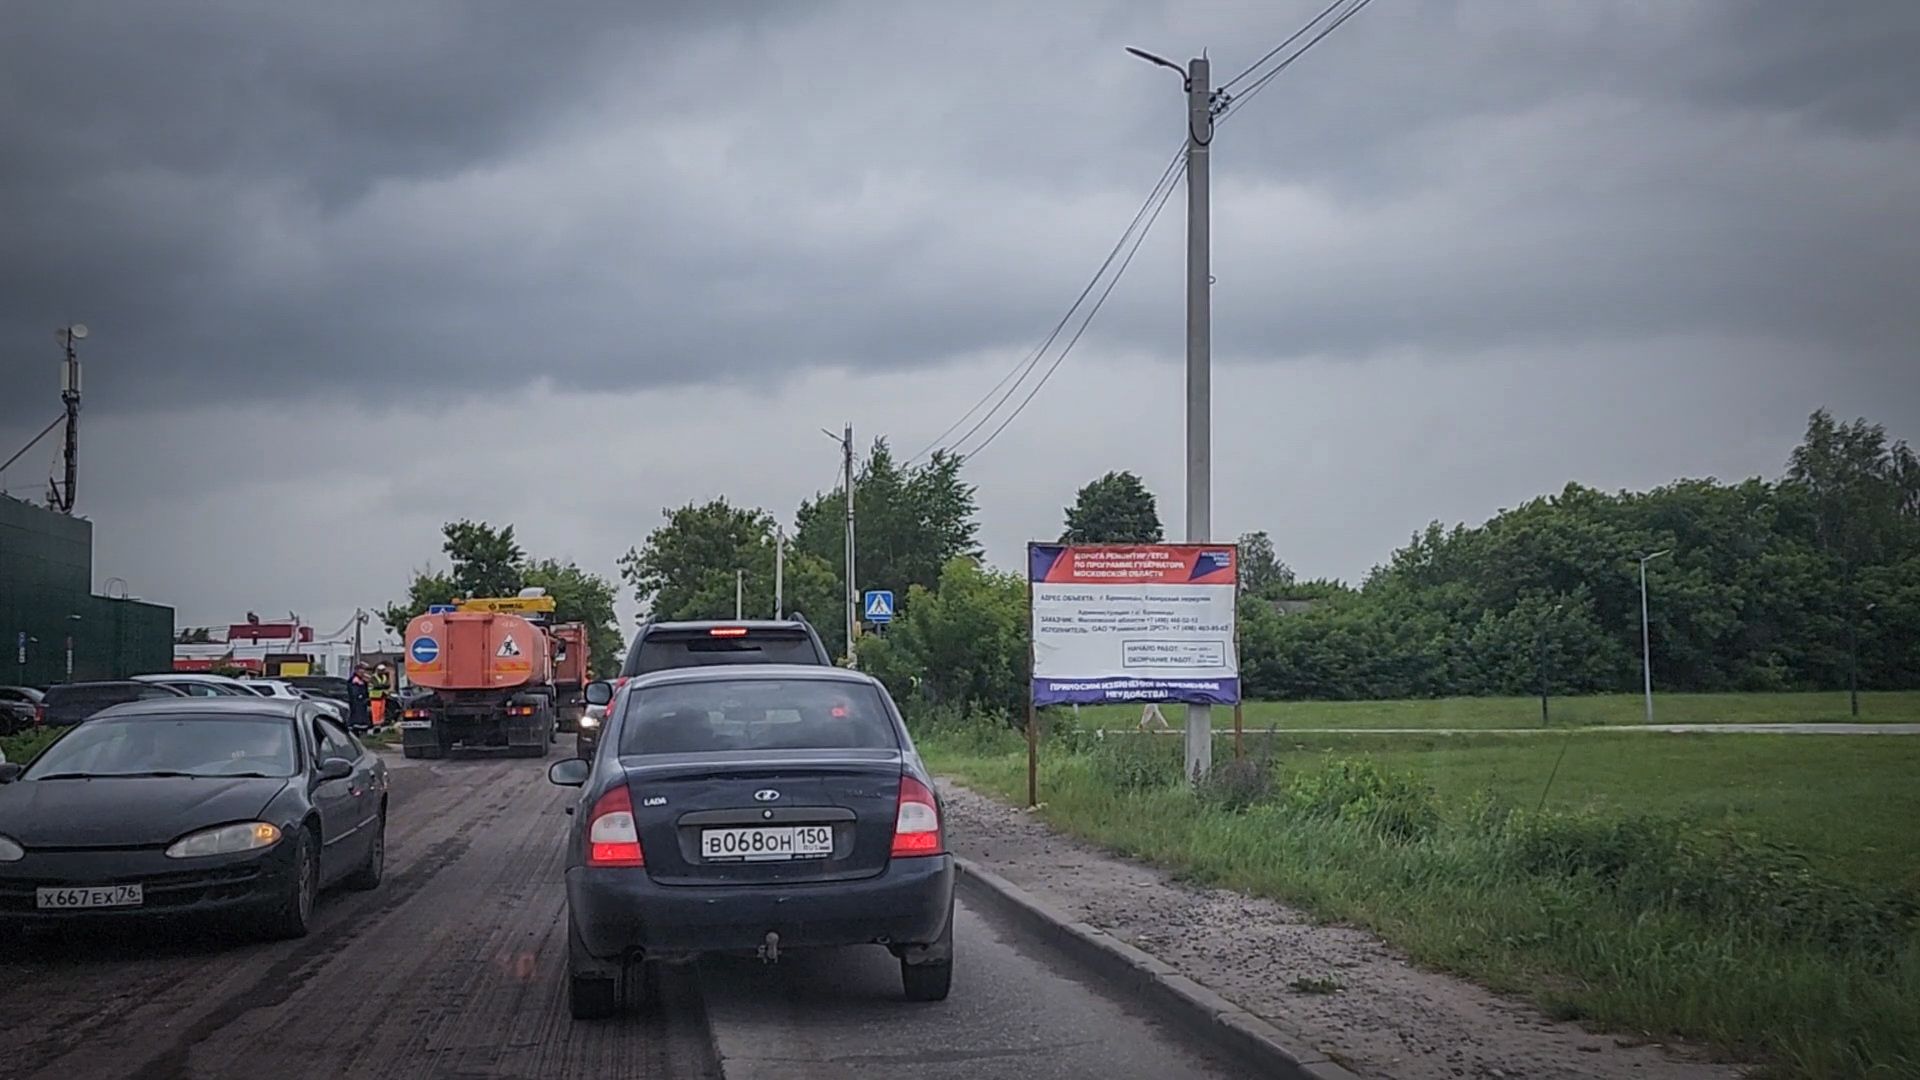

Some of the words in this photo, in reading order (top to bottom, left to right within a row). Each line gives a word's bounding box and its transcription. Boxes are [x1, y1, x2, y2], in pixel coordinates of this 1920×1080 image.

[1074, 552, 1105, 560] ДОРОГА
[1134, 561, 1185, 569] ГУБЕРНАТОРА
[1073, 569, 1127, 577] МОСКОВСКОЙ
[1050, 682, 1100, 691] ПРИНОСИМ
[643, 796, 667, 806] LADA
[797, 828, 827, 844] 150
[119, 886, 136, 900] 76
